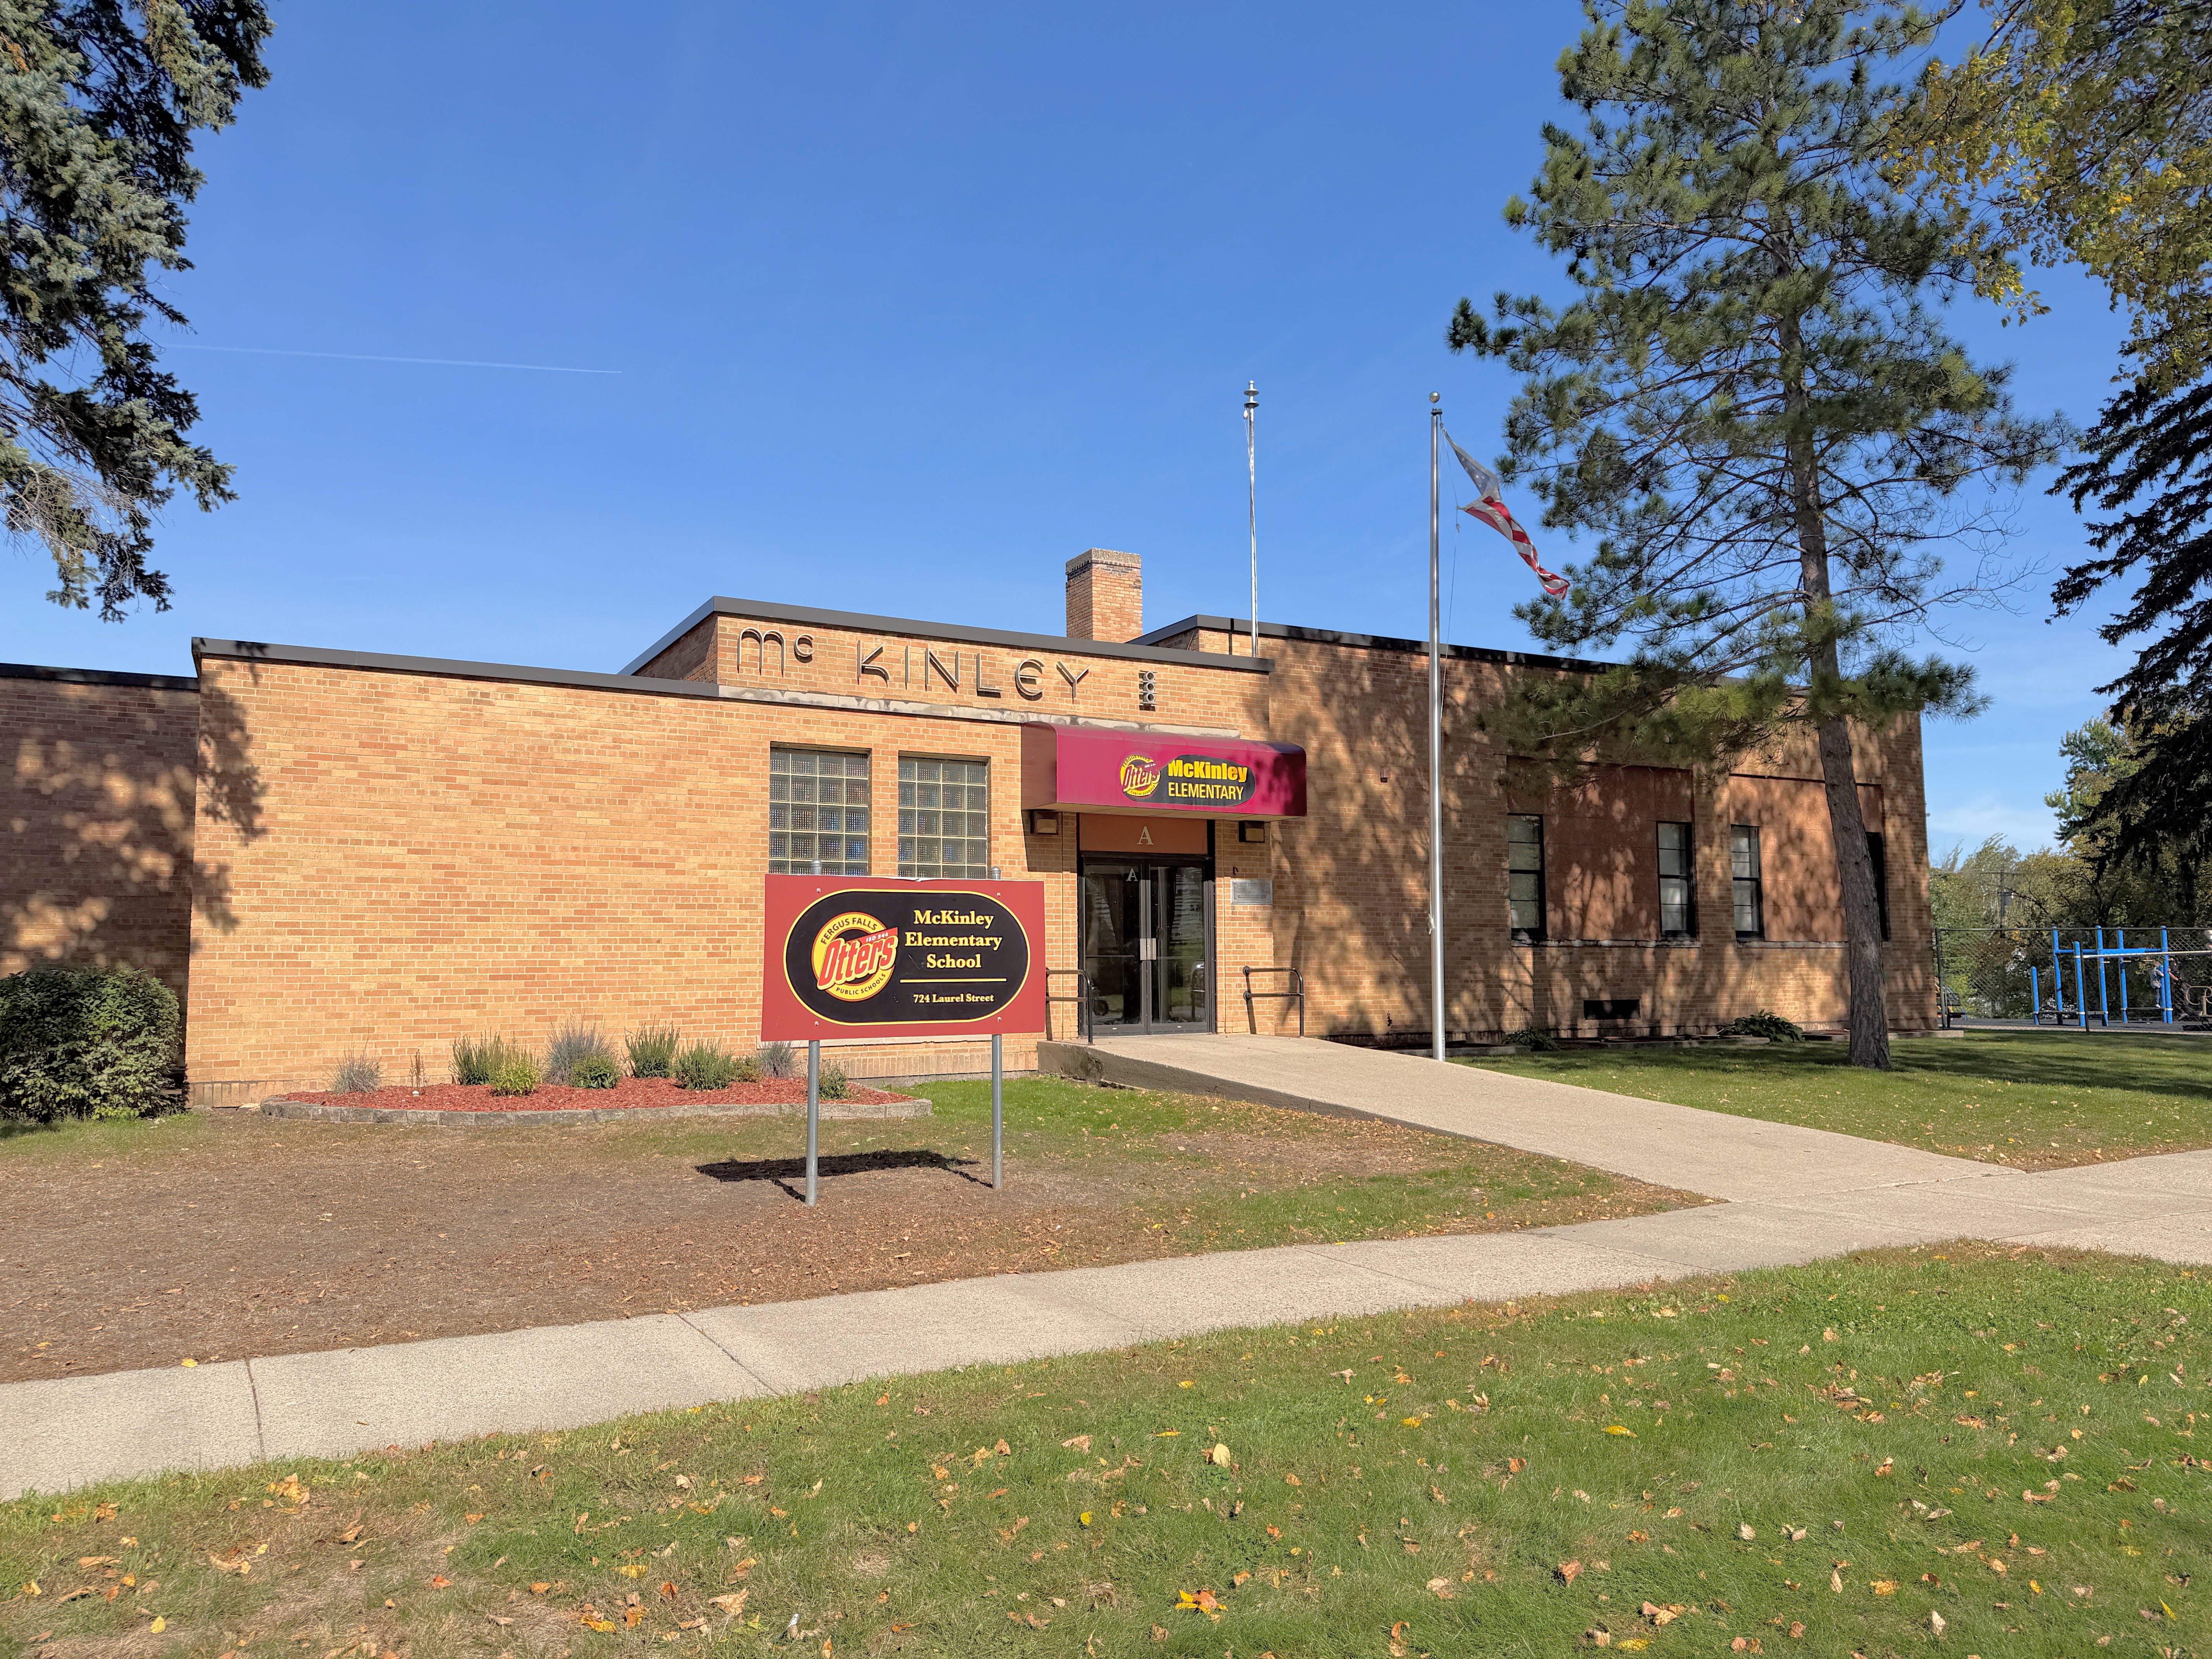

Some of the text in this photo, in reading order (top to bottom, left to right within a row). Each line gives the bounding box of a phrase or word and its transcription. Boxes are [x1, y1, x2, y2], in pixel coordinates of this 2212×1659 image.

[857, 640, 1092, 698] KINLEY
[1168, 759, 1248, 782] McKinley
[1168, 782, 1244, 800] ELEMENTARY
[1137, 826, 1154, 845] A
[1126, 867, 1138, 881] A
[914, 910, 994, 929] McKinley
[821, 917, 878, 945] FERGUS FALLS
[866, 931, 876, 943] ISD
[904, 932, 1003, 951] Elementary
[817, 936, 897, 989] Otters
[926, 953, 982, 969] School
[835, 972, 886, 995] PUBLIC SCHOOLS
[913, 993, 994, 1003] 724 Laurel Street
